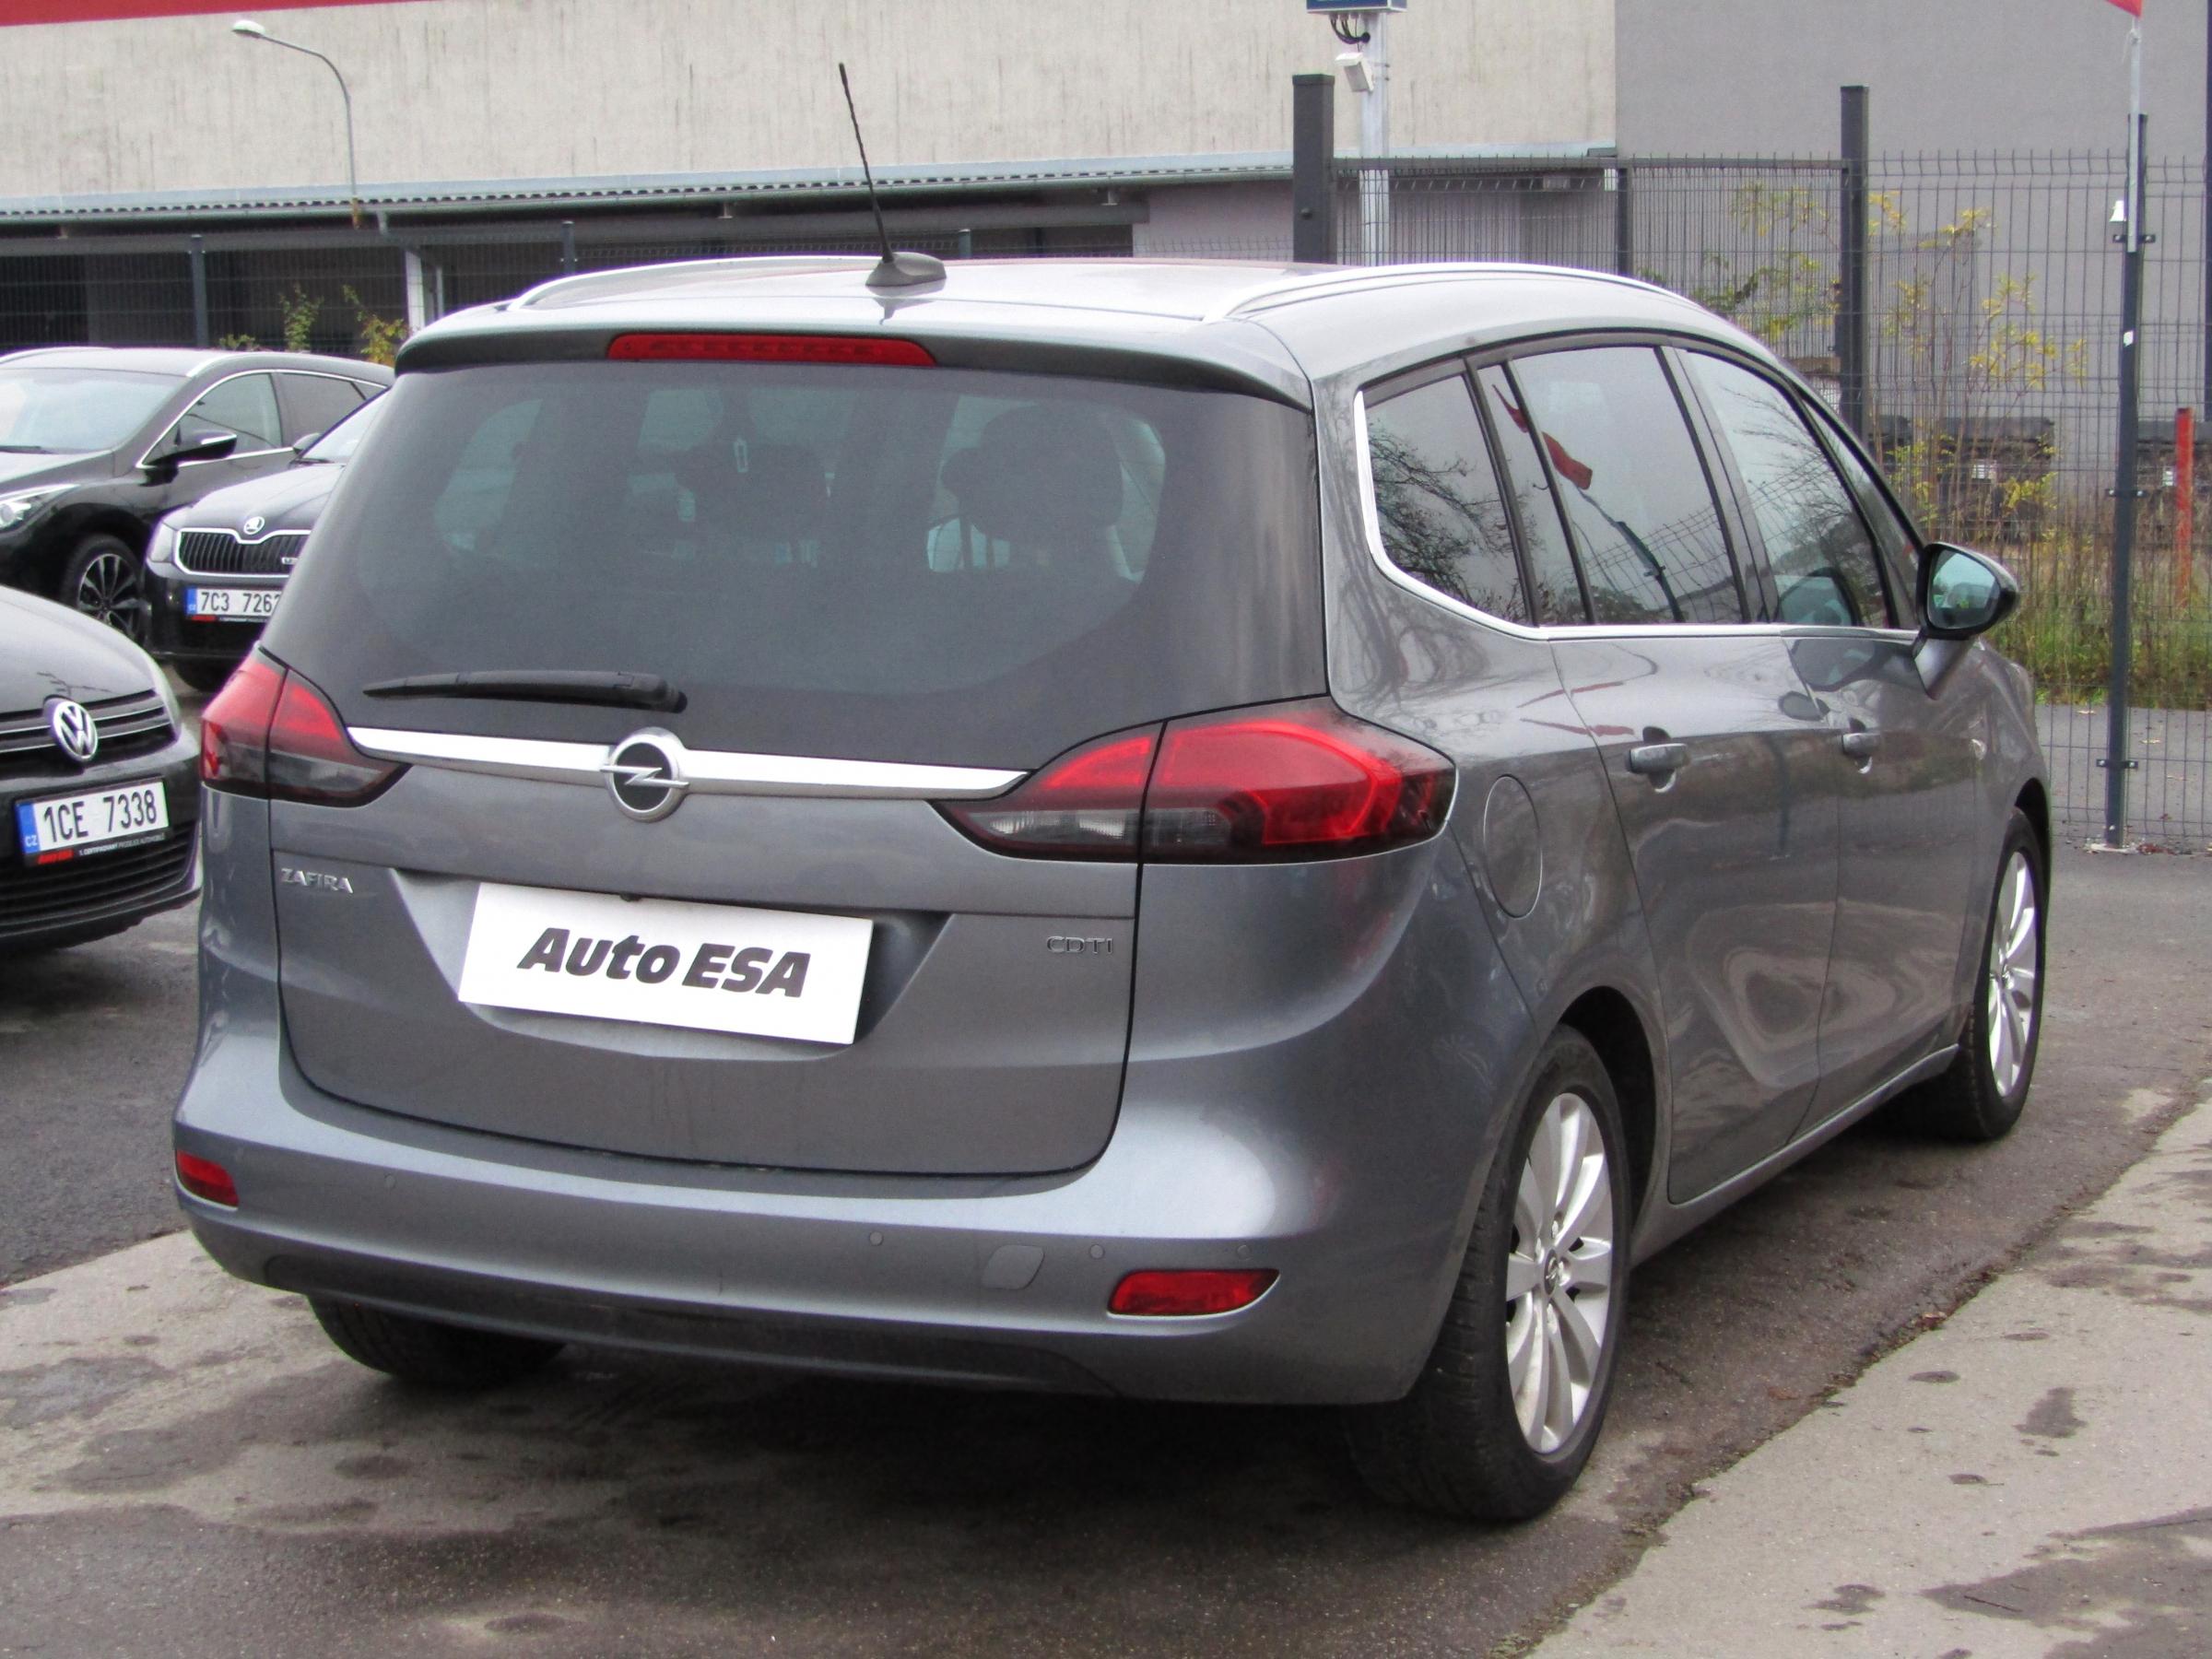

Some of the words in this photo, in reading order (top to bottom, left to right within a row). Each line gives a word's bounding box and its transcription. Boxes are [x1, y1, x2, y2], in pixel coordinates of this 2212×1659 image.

[200, 592, 229, 612] 7C3
[43, 800, 89, 843] 1CE
[102, 789, 158, 833] 7338
[25, 834, 39, 848] CZ
[280, 867, 354, 894] ZAFIRA
[1046, 935, 1113, 955] CDTI
[516, 926, 682, 985] Auto
[680, 942, 812, 998] ESA
